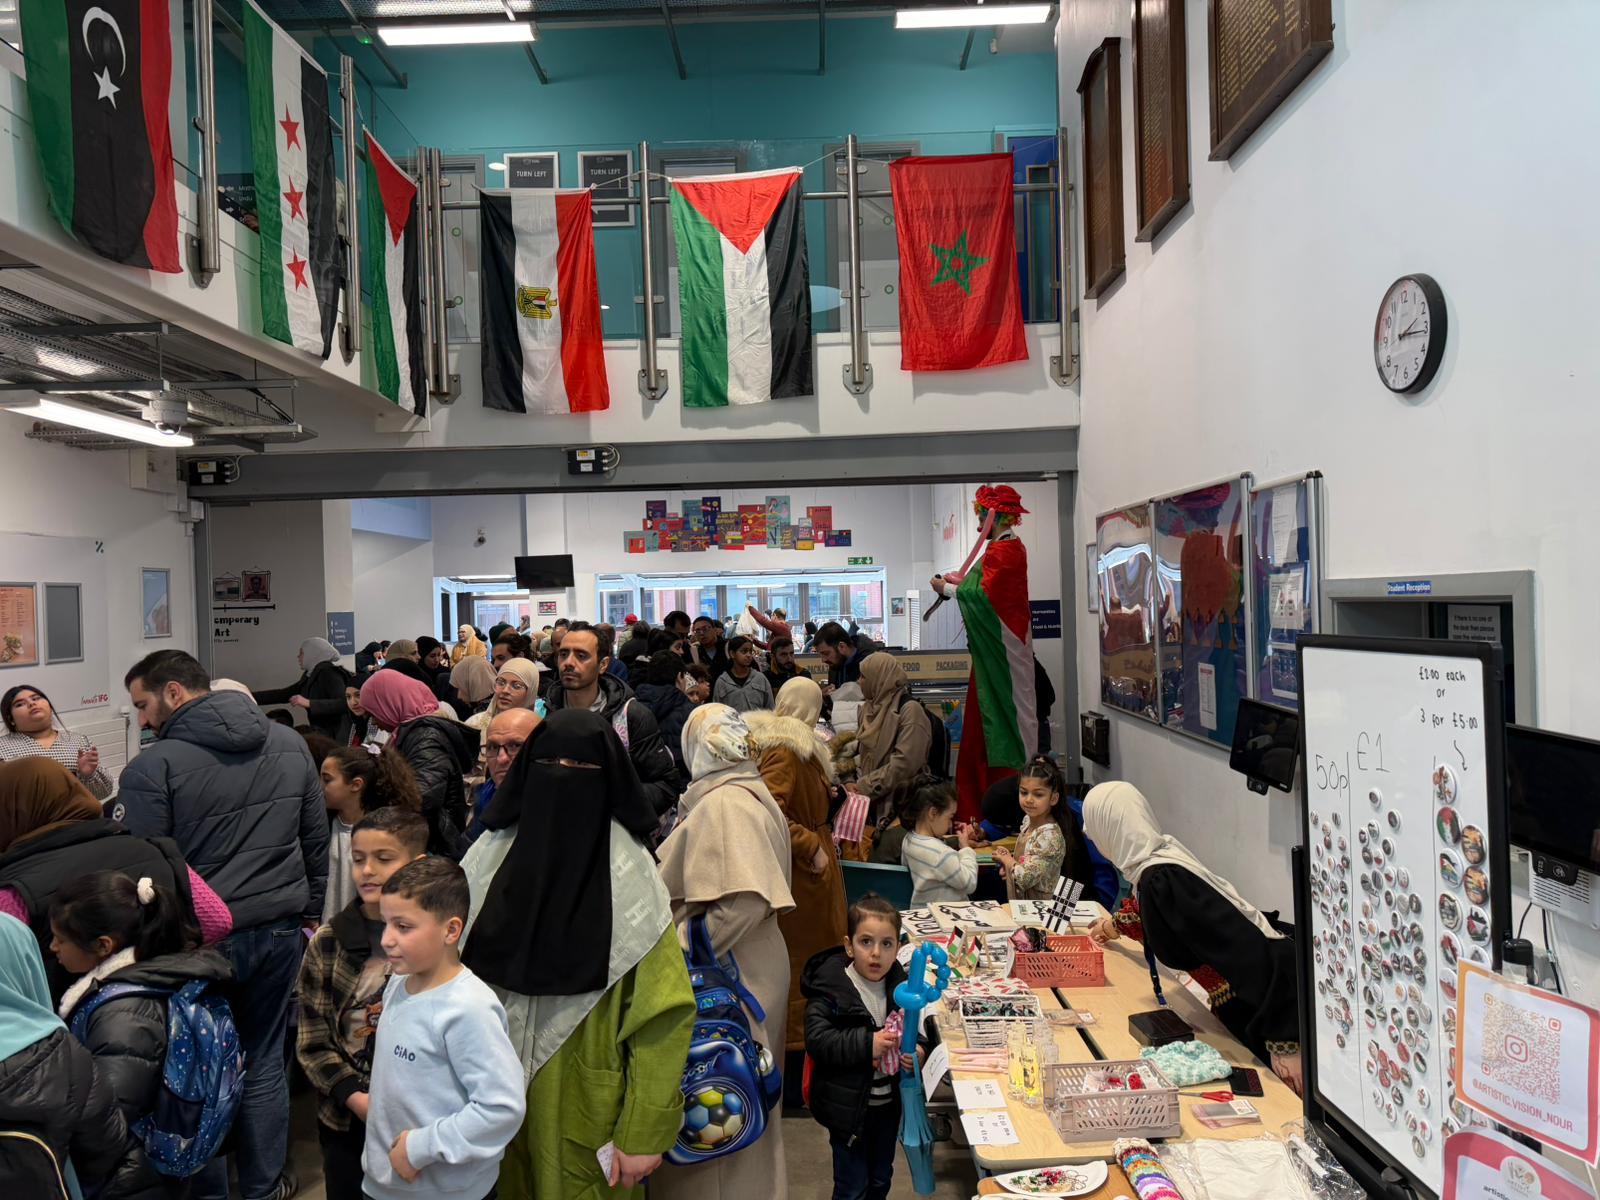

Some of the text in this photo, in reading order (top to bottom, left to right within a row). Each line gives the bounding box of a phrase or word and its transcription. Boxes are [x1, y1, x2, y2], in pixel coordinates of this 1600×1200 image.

[1388, 583, 1430, 592] Student Reception
[215, 628, 230, 637] Art
[902, 661, 968, 671] FOOD PACKAGING
[1446, 671, 1466, 681] each
[1436, 688, 1446, 698] or
[1420, 708, 1426, 723] 3
[1432, 713, 1444, 728] for
[1315, 754, 1348, 798] 50p
[1472, 1078, 1573, 1132] @ARTISTIC.VISION_NOUR
